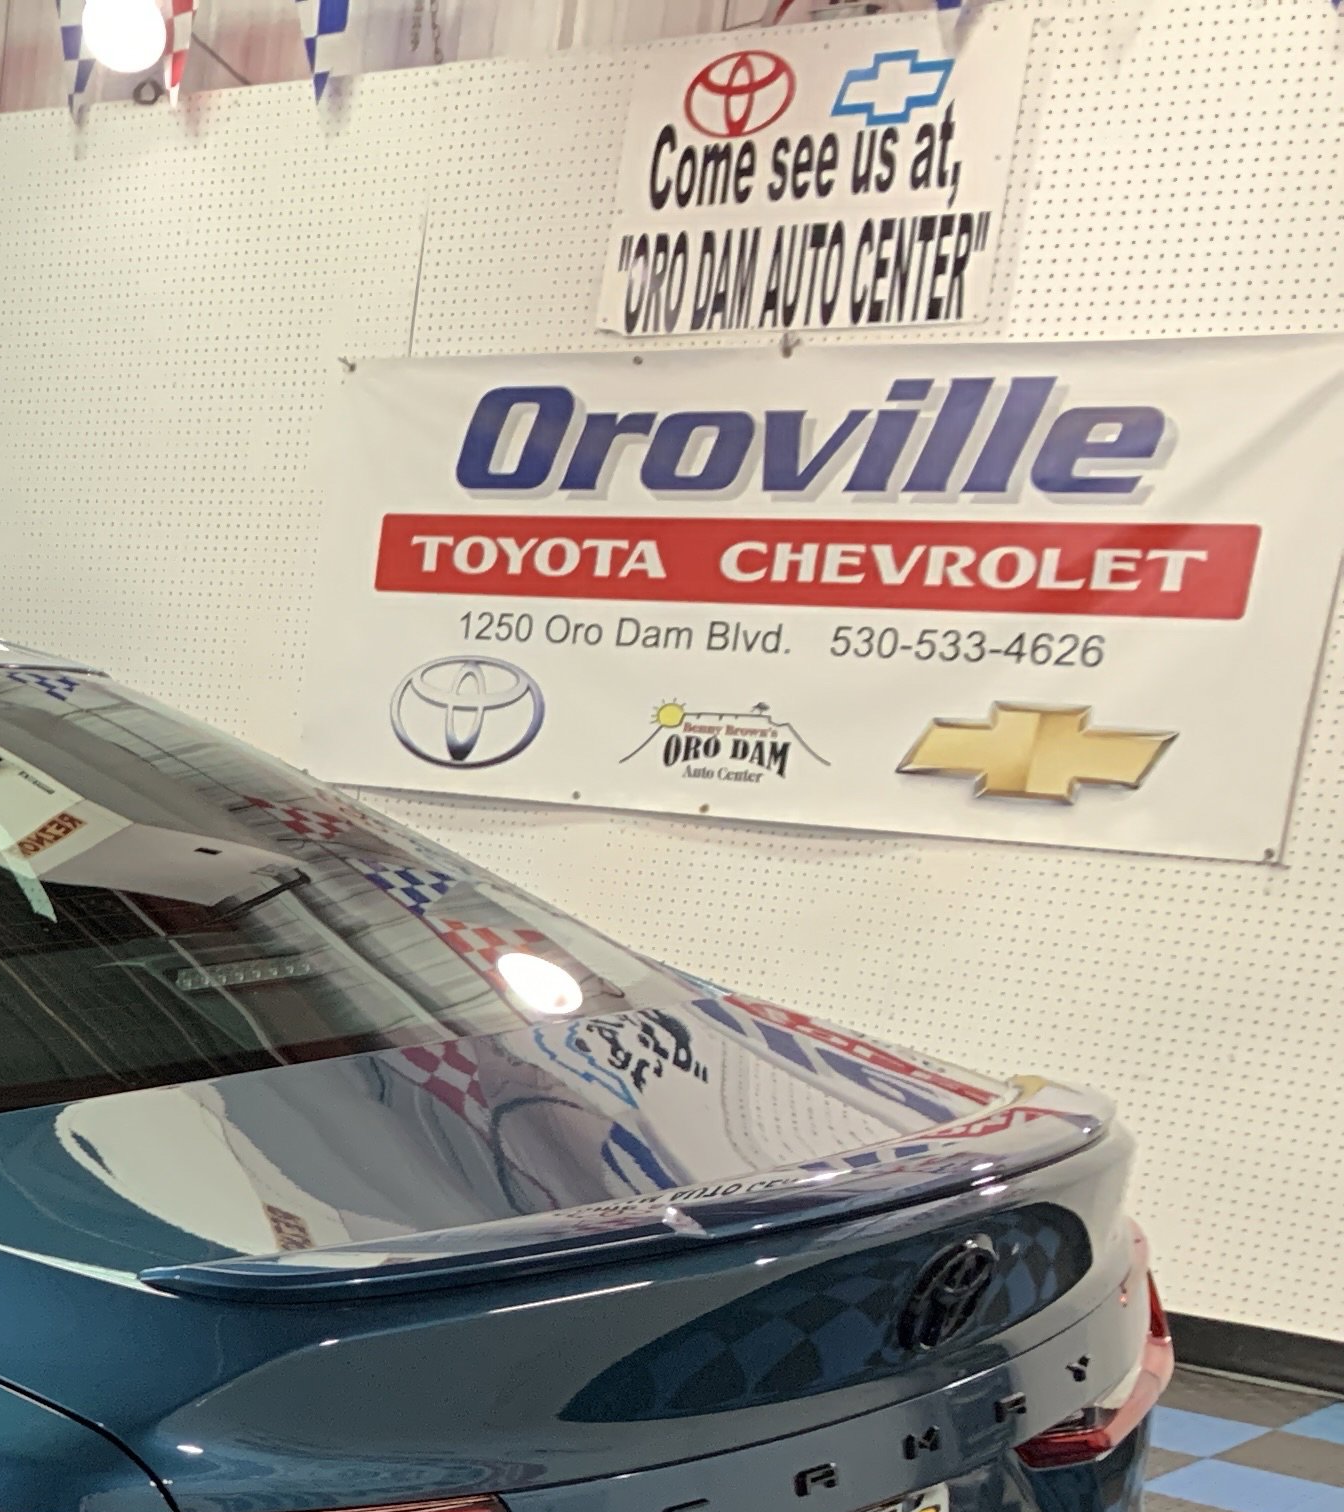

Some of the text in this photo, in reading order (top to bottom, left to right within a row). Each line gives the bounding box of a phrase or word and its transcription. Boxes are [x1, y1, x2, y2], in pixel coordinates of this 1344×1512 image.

[650, 99, 962, 210] Come see us at,
[690, 226, 762, 331] DAM
[759, 220, 845, 329] AUTO
[456, 376, 1174, 500] Oroville
[411, 534, 1209, 593] TOYOTA CHEVROLET
[458, 610, 1106, 668] 1250 Oro Dam Blvd. 530-533-4626
[663, 734, 791, 778] ORO DAM
[682, 765, 763, 783] Auto Center
